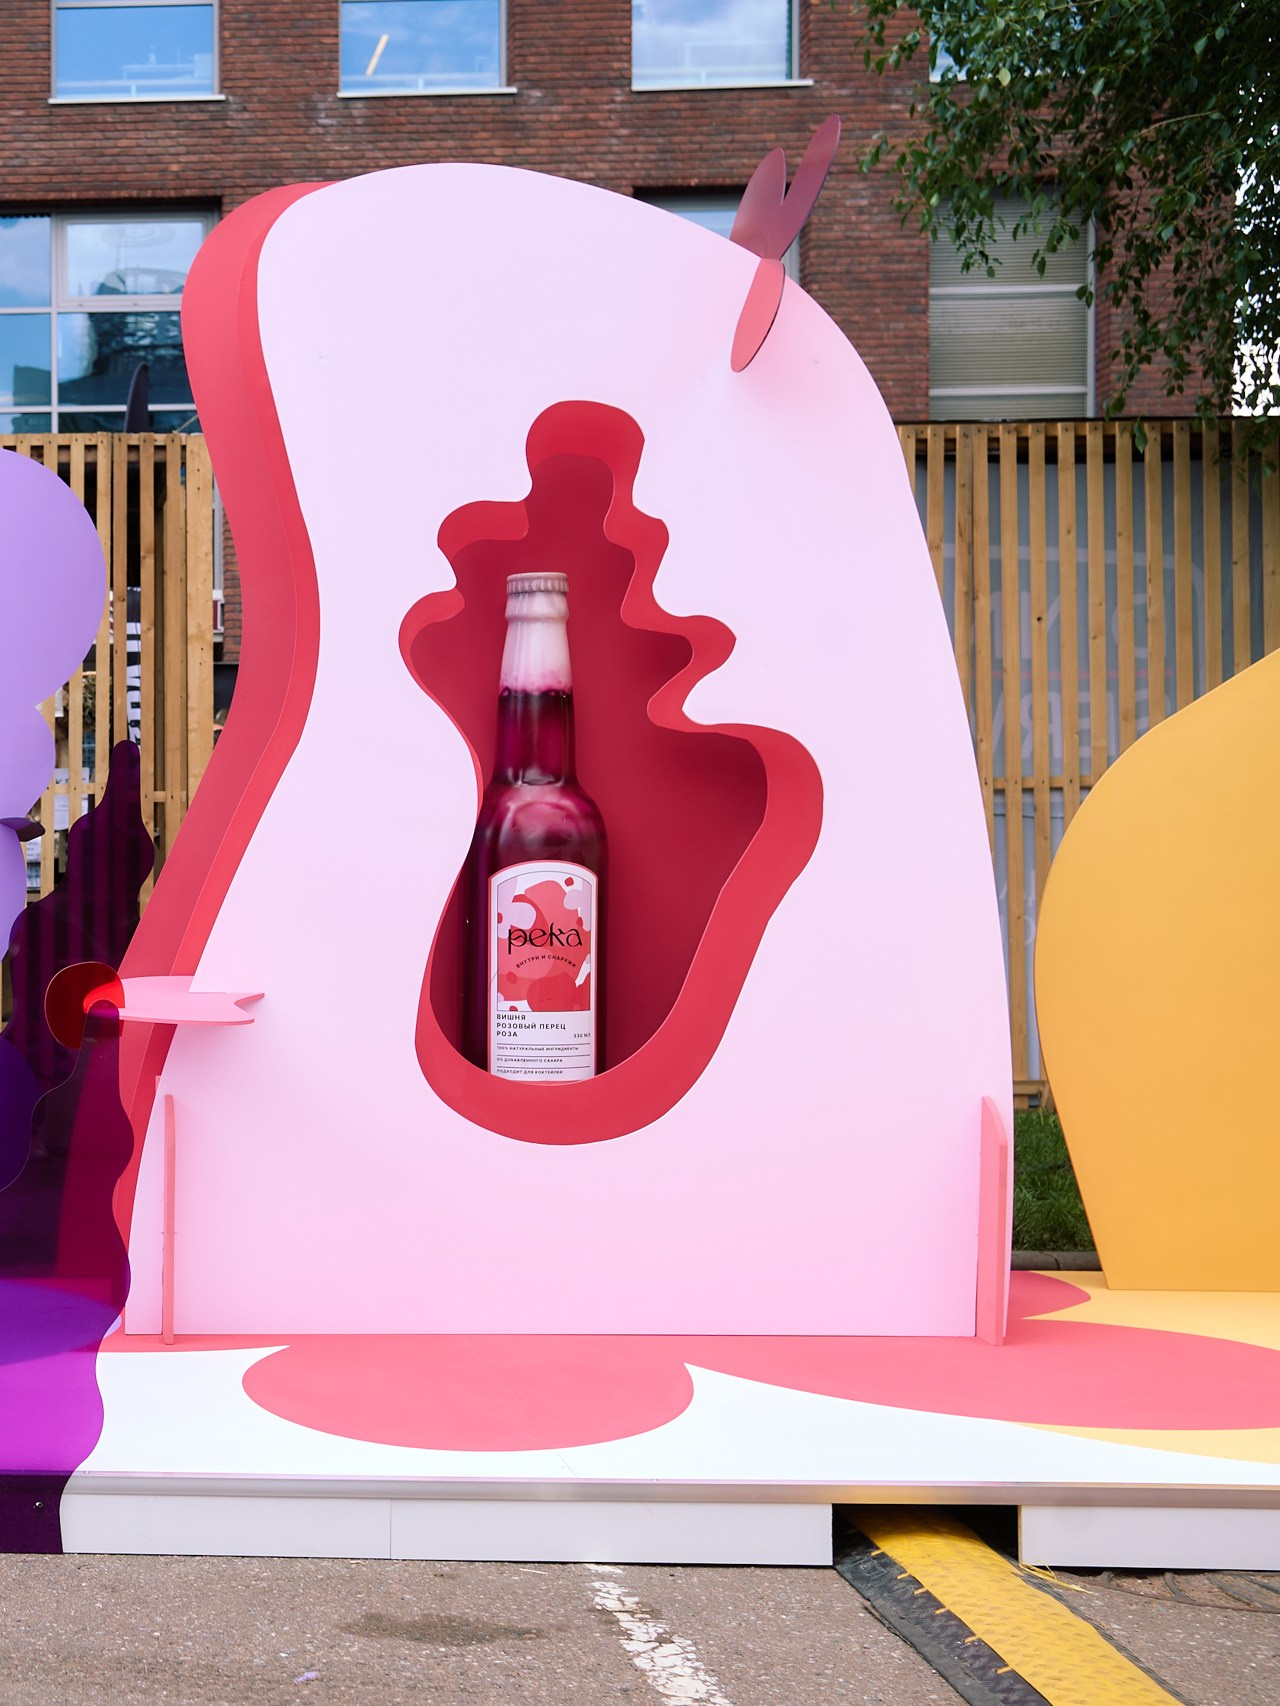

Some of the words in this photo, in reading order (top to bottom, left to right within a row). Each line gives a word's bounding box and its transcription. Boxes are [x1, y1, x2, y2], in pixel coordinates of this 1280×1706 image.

[508, 922, 582, 955] река
[516, 955, 539, 968] ВНУТРИ
[547, 954, 576, 968] СНАРУЖИ
[496, 1022, 537, 1030] РОЗОВЫЙ
